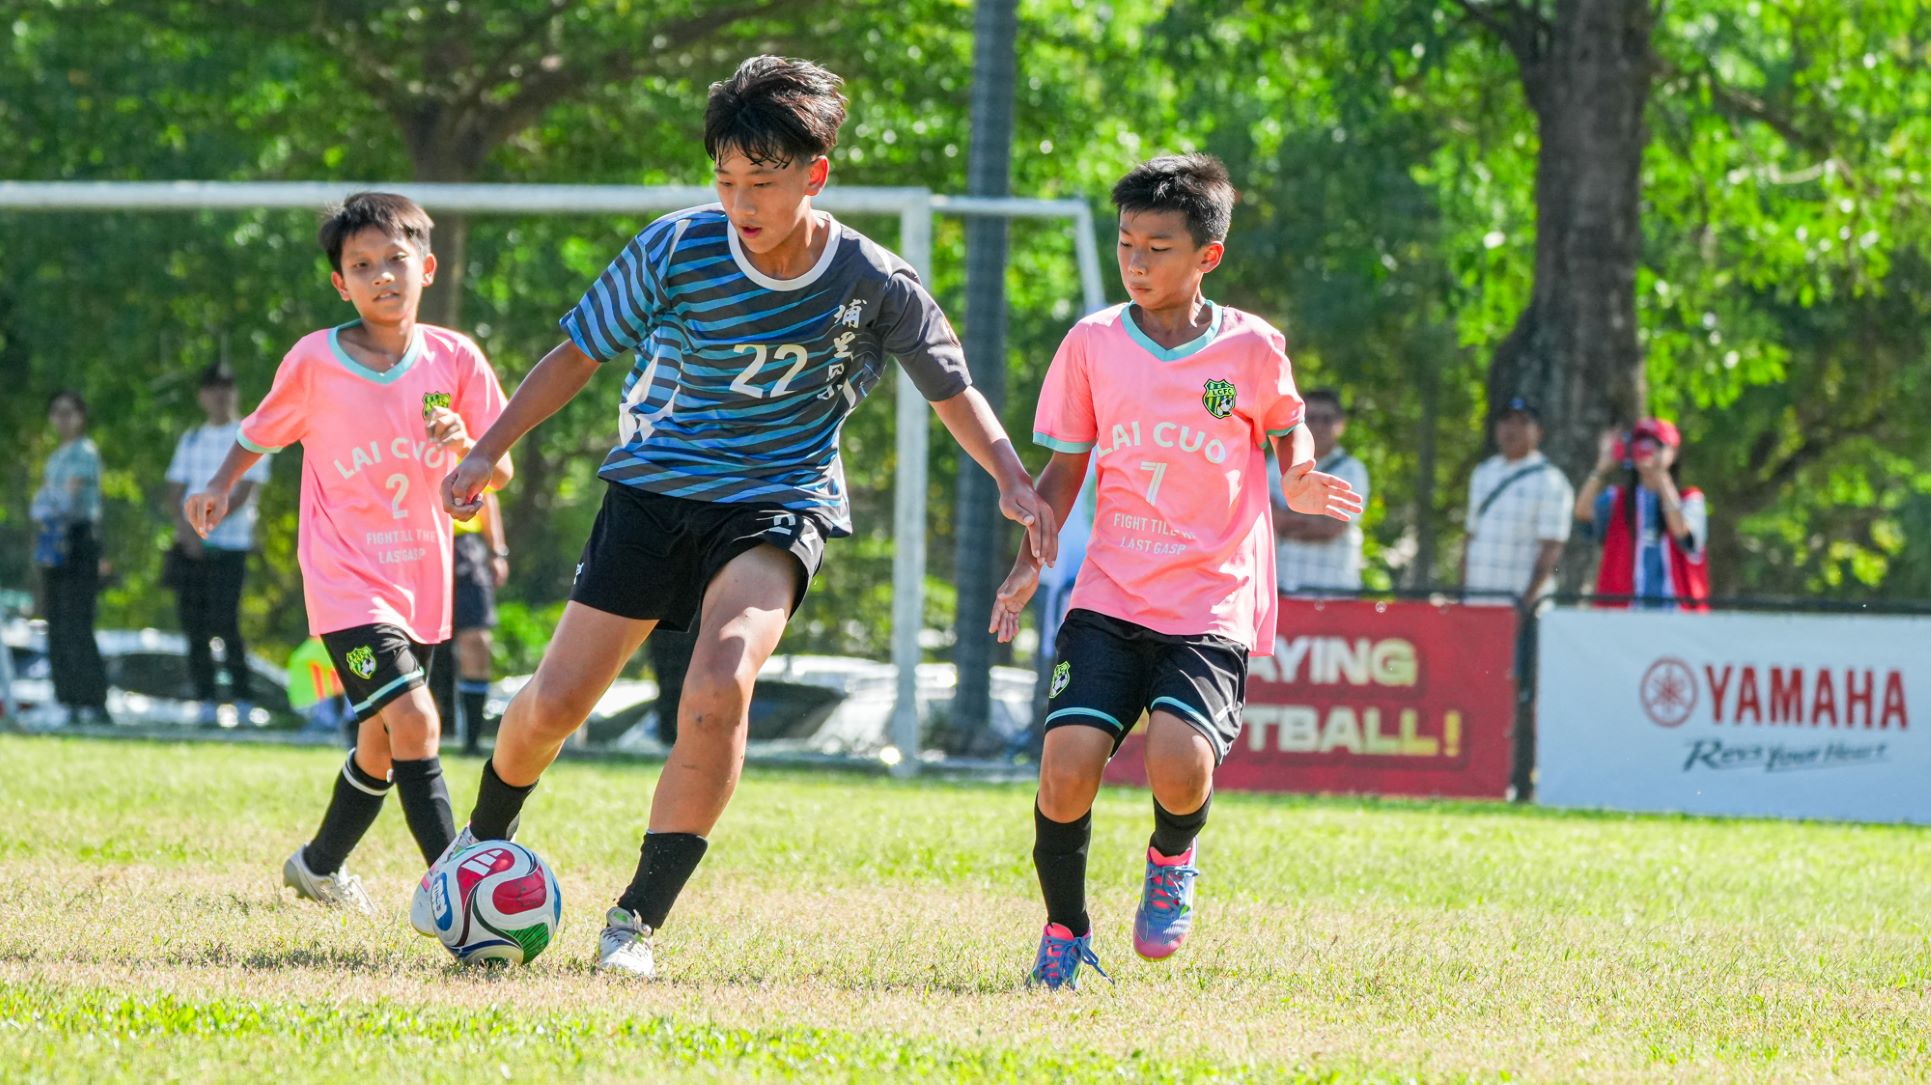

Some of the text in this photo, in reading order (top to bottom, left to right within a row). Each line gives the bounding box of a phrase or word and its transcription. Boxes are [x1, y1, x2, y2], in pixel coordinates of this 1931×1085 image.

[729, 344, 808, 399] 22
[333, 441, 382, 480] LAI
[1097, 421, 1227, 464] LAI CUO
[385, 473, 410, 520] 2
[1140, 461, 1168, 507] 7
[366, 530, 399, 545] FIGHT
[416, 528, 437, 543] THE
[1113, 512, 1148, 532] FIGHT
[377, 549, 401, 564] LAS
[1120, 535, 1187, 556] LAST GASP
[1704, 663, 1909, 730] YAMAHA
[1242, 703, 1462, 757] TBALL!
